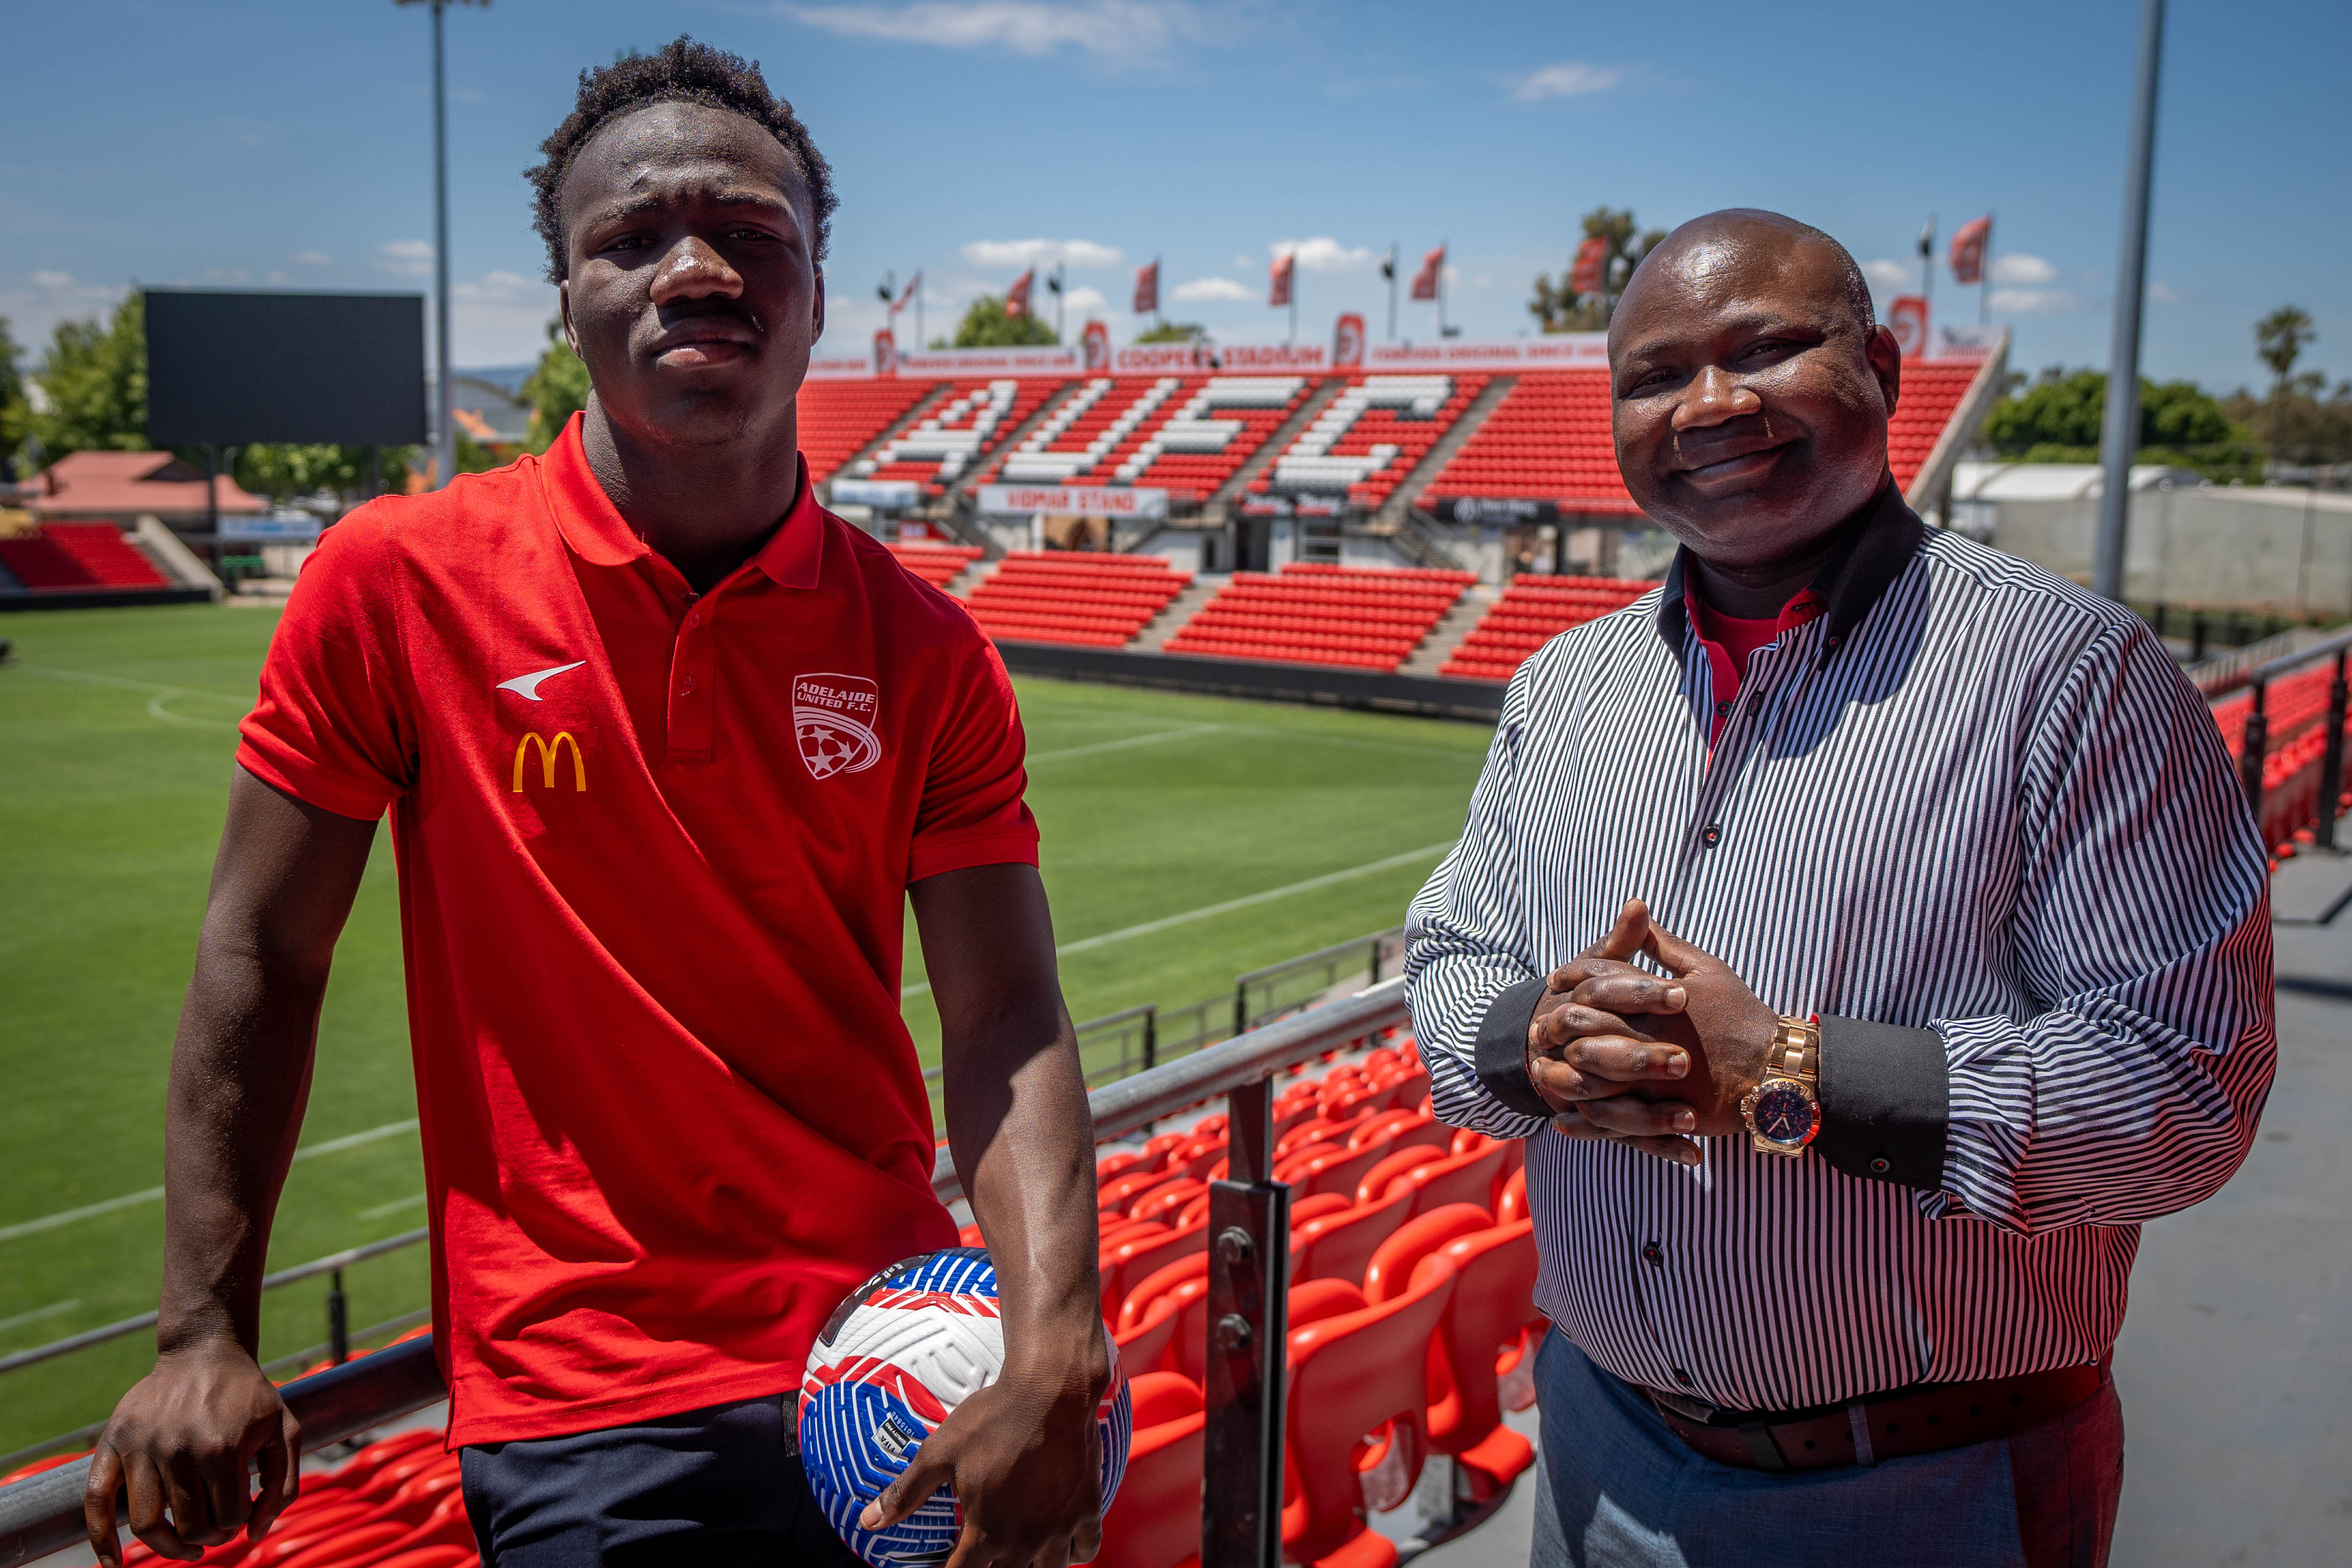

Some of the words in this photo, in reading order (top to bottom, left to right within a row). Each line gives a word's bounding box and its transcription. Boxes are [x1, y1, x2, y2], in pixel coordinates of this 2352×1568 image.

[1223, 346, 1325, 365] STADIUM
[1079, 491, 1136, 513] STAND
[797, 682, 875, 703] ADELAIDE
[797, 692, 843, 708] UNITED
[846, 702, 871, 712] F.C.
[885, 1422, 895, 1433] PRO
[892, 1429, 906, 1445] QUALITY
[880, 1435, 896, 1453] FIFA
